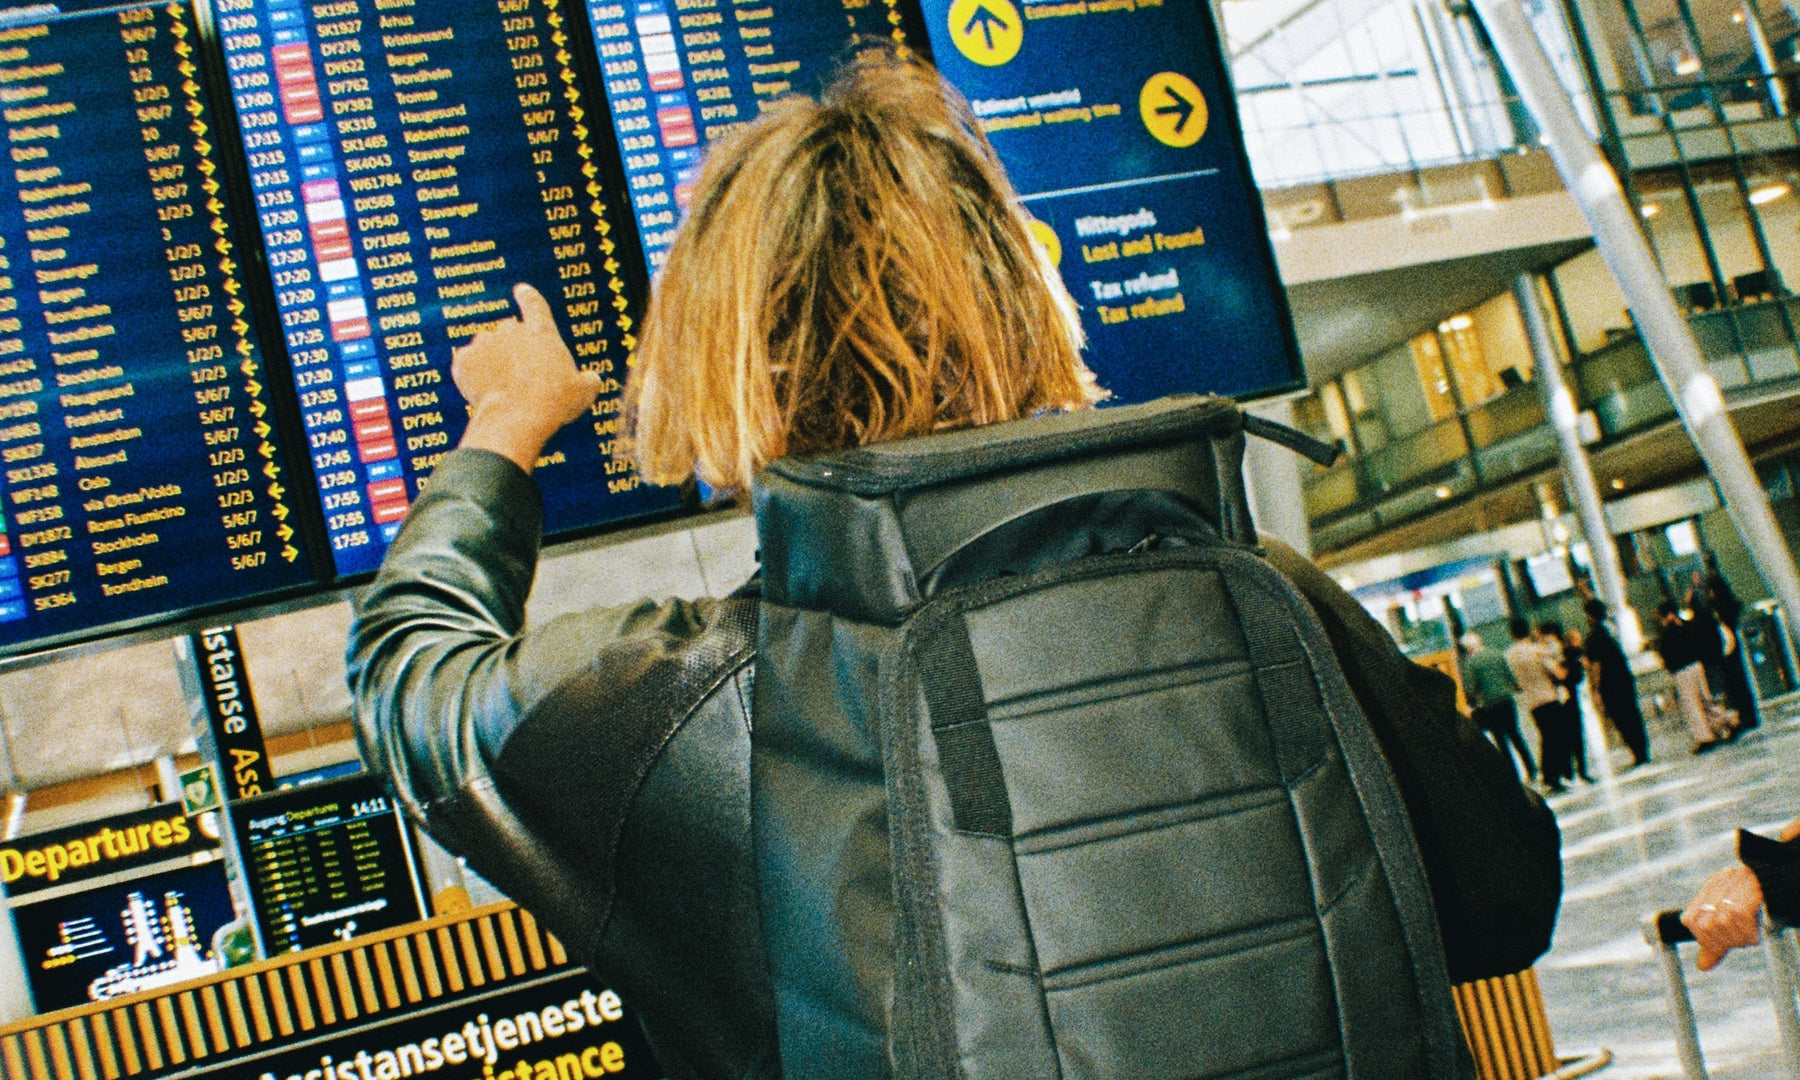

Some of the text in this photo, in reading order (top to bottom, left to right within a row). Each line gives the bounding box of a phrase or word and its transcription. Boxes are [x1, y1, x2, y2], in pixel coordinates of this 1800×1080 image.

[220, 14, 257, 31] 17:00
[225, 33, 260, 50] 17:00
[228, 52, 265, 69] 17:00
[232, 71, 268, 88] 17:00
[236, 91, 273, 108] 17:00
[240, 111, 277, 128] 17:10
[245, 130, 280, 147] 17:15
[249, 150, 285, 167] 17:15
[253, 169, 289, 186] 17:15
[257, 189, 293, 207] 17:15
[262, 209, 298, 226] 17:20
[266, 229, 302, 246] 17:20
[270, 248, 306, 266] 17:20
[545, 204, 577, 220] 1/2/3
[1082, 226, 1205, 263] Lost and Found
[274, 268, 310, 286] 17:20
[1089, 268, 1179, 300] Tax refund
[278, 288, 314, 306] 17:20
[283, 308, 319, 325] 17:20
[559, 262, 590, 278] 1/2/3
[287, 328, 323, 346] 17:25
[563, 282, 595, 298] 1/2/3
[1097, 292, 1185, 324] Tax refund
[292, 348, 328, 366] 17:30
[567, 300, 598, 317] 5/6/7
[296, 368, 332, 386] 17:30
[571, 320, 602, 336] 5/6/7
[195, 386, 229, 403] 5/6/7
[301, 388, 337, 407] 17:35
[199, 407, 234, 424] 5/6/7
[305, 409, 341, 427] 17:40
[204, 427, 238, 444] 5/6/7
[310, 429, 346, 447] 17:40
[209, 448, 244, 465] 1/2/3
[314, 449, 350, 468] 17:45
[214, 469, 248, 486] 1/2/3
[319, 470, 355, 488] 17:50
[324, 490, 359, 509] 17:55
[87, 517, 124, 533] Roma
[218, 490, 253, 507] 1/2/3
[328, 511, 364, 529] 17:55
[92, 510, 256, 554] Stockholm 5/6/7
[333, 530, 368, 549] 17:55
[96, 559, 141, 575] Bergen
[227, 531, 260, 548] 5/6/7
[101, 575, 167, 595] Trondheim
[231, 551, 265, 569] 5/6/7
[0, 815, 191, 882] Departures
